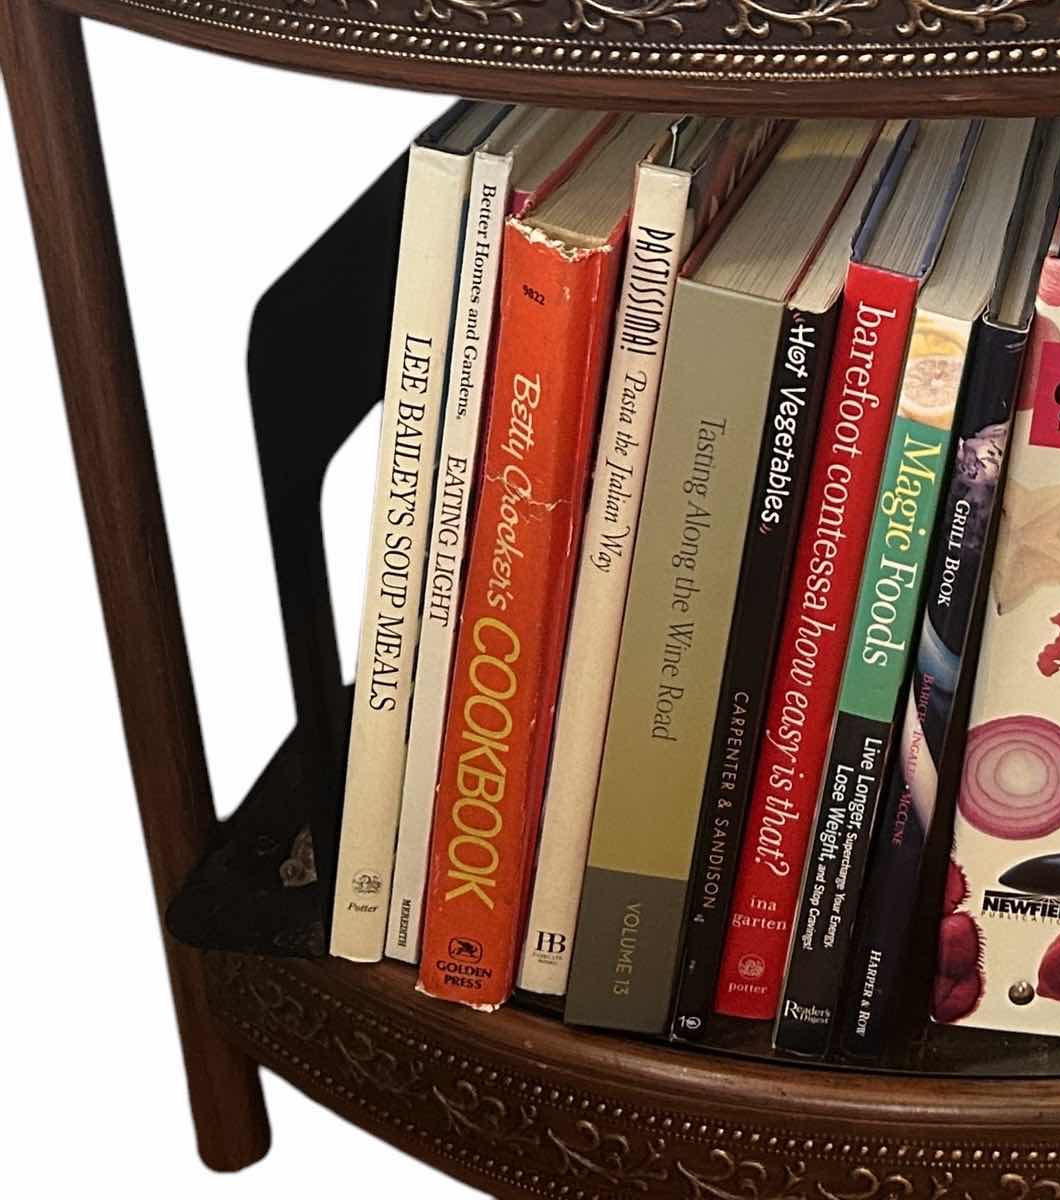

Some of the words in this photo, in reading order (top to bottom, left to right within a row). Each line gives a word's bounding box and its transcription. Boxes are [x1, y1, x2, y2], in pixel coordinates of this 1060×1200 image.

[400, 332, 433, 395] LEE
[619, 369, 648, 424] Pasta
[386, 401, 426, 528] BAILEY'S
[614, 429, 640, 457] the
[682, 416, 728, 499] Tasting
[438, 454, 468, 548] EATING
[603, 456, 634, 524] Italian
[881, 431, 943, 552] Magic
[589, 525, 631, 575] Way
[671, 500, 711, 573] Along
[947, 499, 971, 550] GRILL
[379, 532, 413, 609] SOUP
[428, 551, 456, 629] LIGHT
[671, 576, 701, 614] the
[937, 555, 961, 608] BOOK
[861, 553, 918, 667] Foods
[368, 612, 404, 713] MEALS
[661, 620, 695, 678] Wine
[651, 682, 685, 743] Road
[831, 763, 855, 803] Lose
[819, 805, 848, 862] Weight,
[808, 884, 826, 906] Stop
[818, 863, 828, 886] and
[346, 901, 379, 915] Potter
[397, 897, 412, 948] MEREDITH
[732, 911, 787, 931] garten
[750, 895, 778, 912] ina
[802, 907, 822, 951] Cravings!
[614, 902, 641, 975] VOLUME
[435, 960, 493, 979] GOLDEN
[443, 974, 483, 990] PRESS
[612, 979, 631, 995] 13
[727, 981, 769, 995] potter
